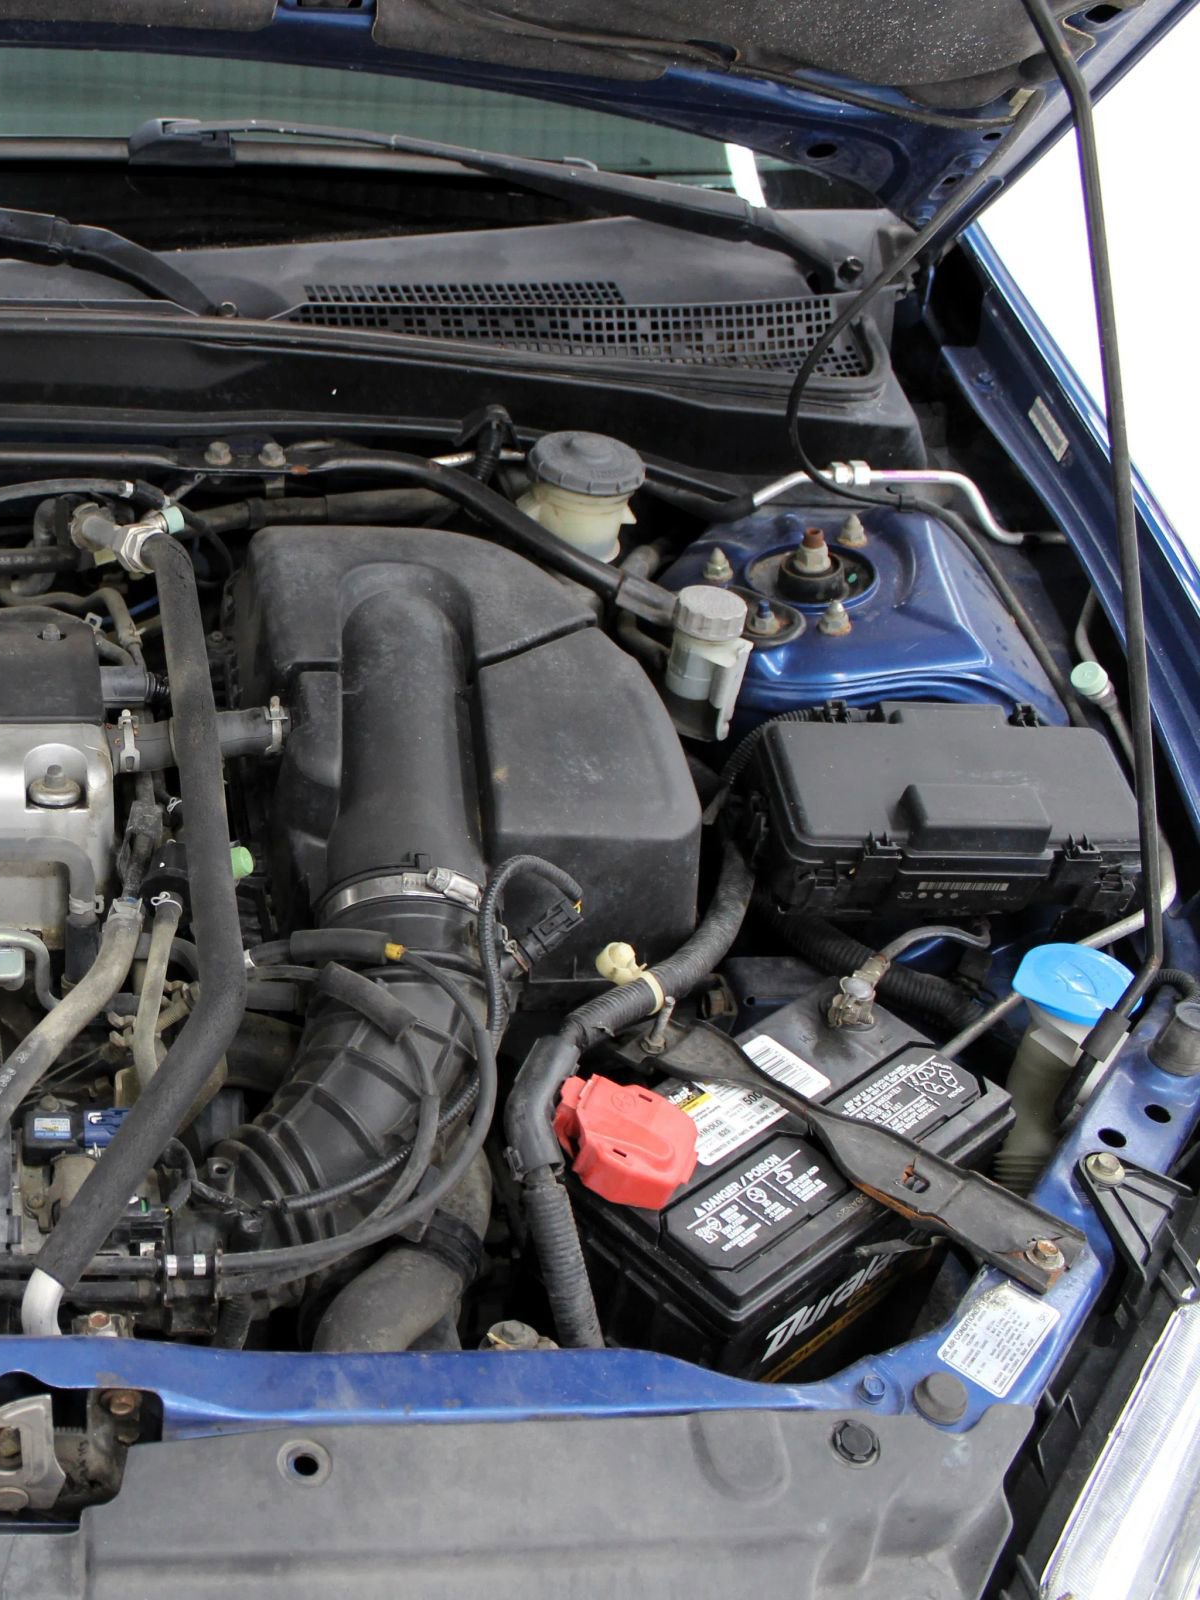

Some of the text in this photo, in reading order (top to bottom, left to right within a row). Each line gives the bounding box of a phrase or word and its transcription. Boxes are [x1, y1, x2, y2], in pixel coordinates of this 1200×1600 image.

[701, 1182, 742, 1212] DANGER
[744, 1153, 782, 1182] POISON
[761, 1252, 894, 1363] Durala
